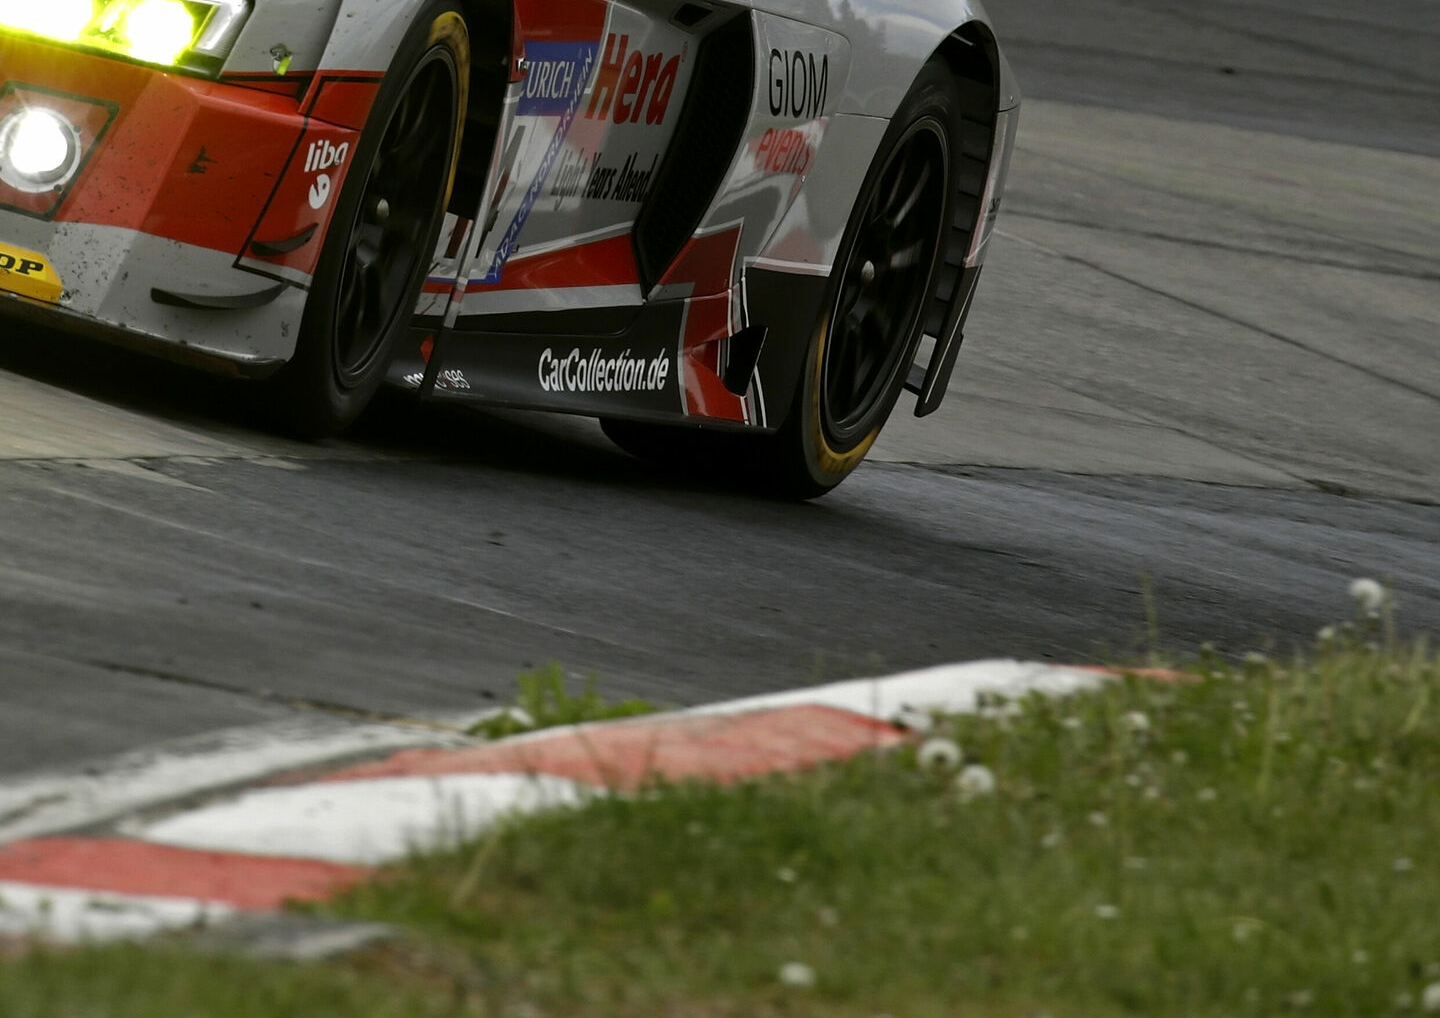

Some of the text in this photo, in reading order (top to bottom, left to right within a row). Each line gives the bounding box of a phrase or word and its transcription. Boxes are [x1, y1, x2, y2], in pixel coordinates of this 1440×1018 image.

[585, 33, 681, 125] Hera
[768, 48, 828, 120] GIOM
[581, 152, 618, 200] Years
[537, 347, 669, 392] CarCollection.de
